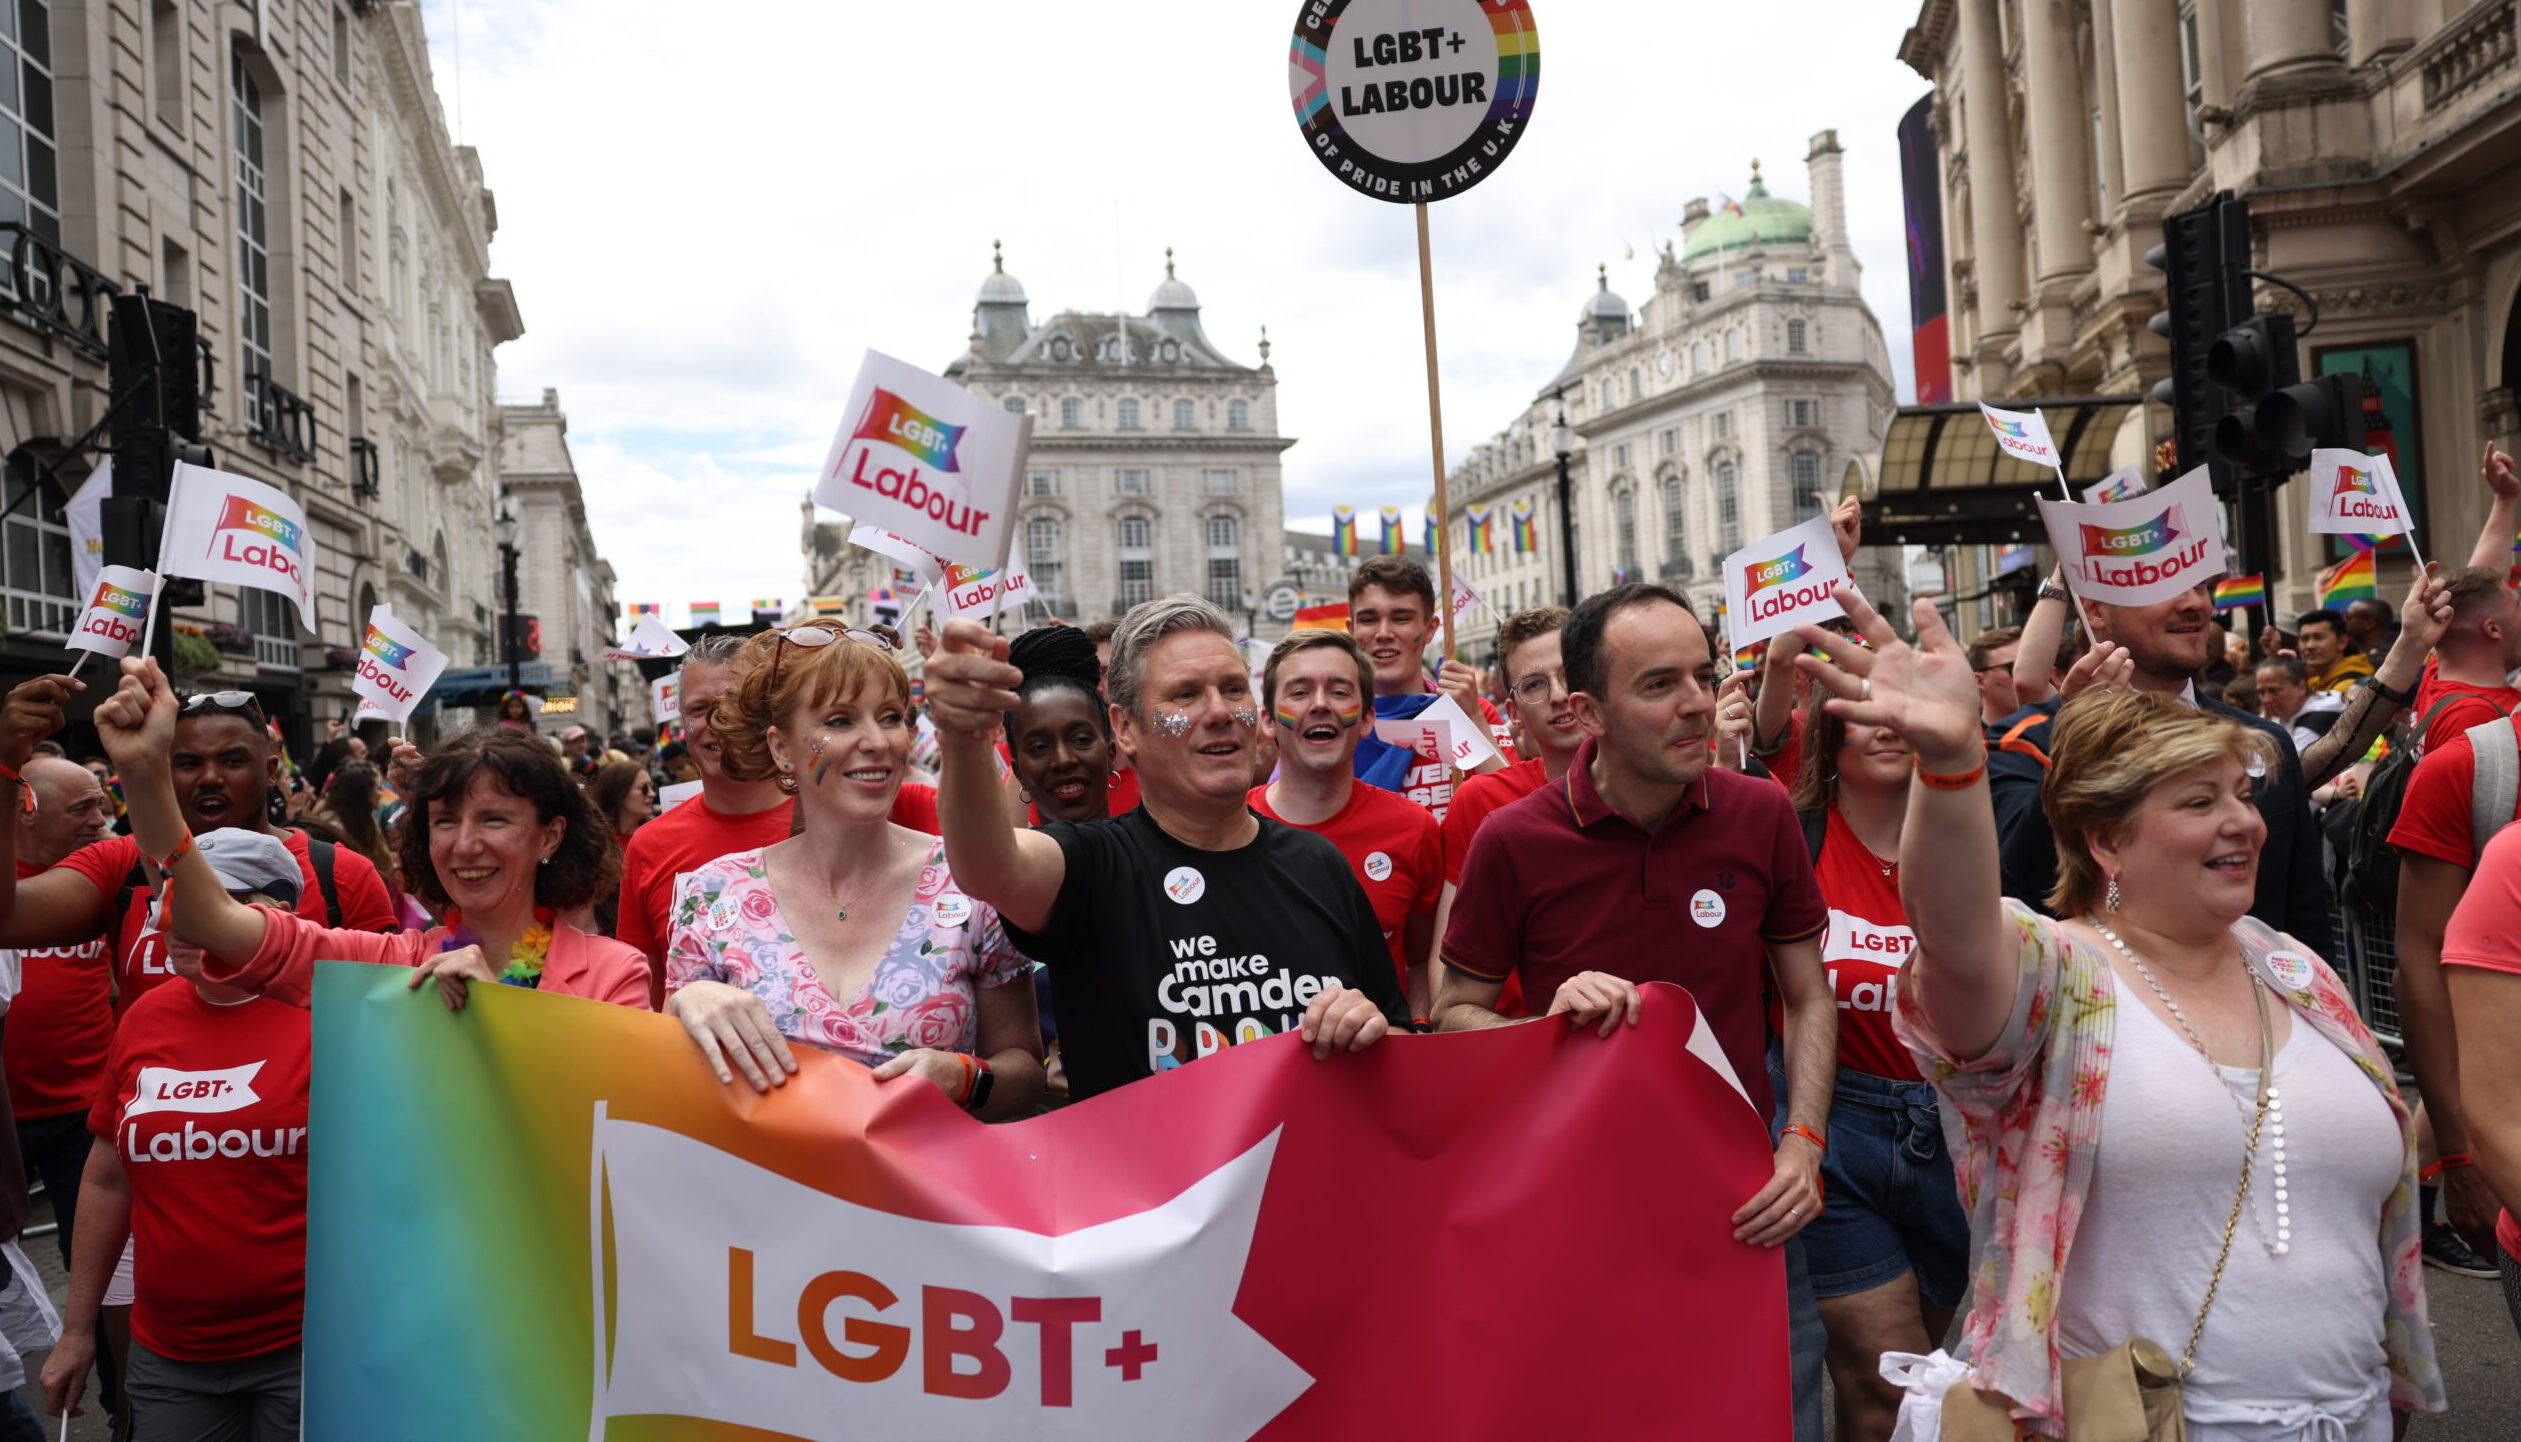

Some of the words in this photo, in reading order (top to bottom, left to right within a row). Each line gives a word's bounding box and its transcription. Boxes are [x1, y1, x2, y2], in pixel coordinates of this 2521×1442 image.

[1353, 27, 1466, 68] LGBT+
[1341, 72, 1487, 117] LABOUR
[1316, 132, 1339, 158] OF
[1339, 159, 1400, 196] PRIDE
[1410, 179, 1433, 196] IN
[1441, 157, 1481, 189] THE
[1483, 112, 1518, 156] U.K.
[888, 413, 947, 453] LGBT+
[851, 448, 989, 536] Labour
[245, 510, 296, 540] LGBT+
[2100, 529, 2160, 549] LGBT+
[224, 534, 307, 603] Labo
[1756, 560, 1796, 583] LGBT+
[2094, 537, 2207, 588] Labour
[101, 591, 142, 609] LGBT+
[82, 612, 137, 644] Labo
[366, 633, 399, 658] LGBT+
[356, 659, 413, 703] abour
[1696, 910, 1722, 918] Labour
[1169, 935, 1217, 958] we
[1852, 931, 1914, 954] LGBT
[1175, 954, 1269, 983] make
[156, 1080, 233, 1100] LGBT+
[128, 1121, 306, 1162] Labour
[728, 1246, 1158, 1408] LGBT+
